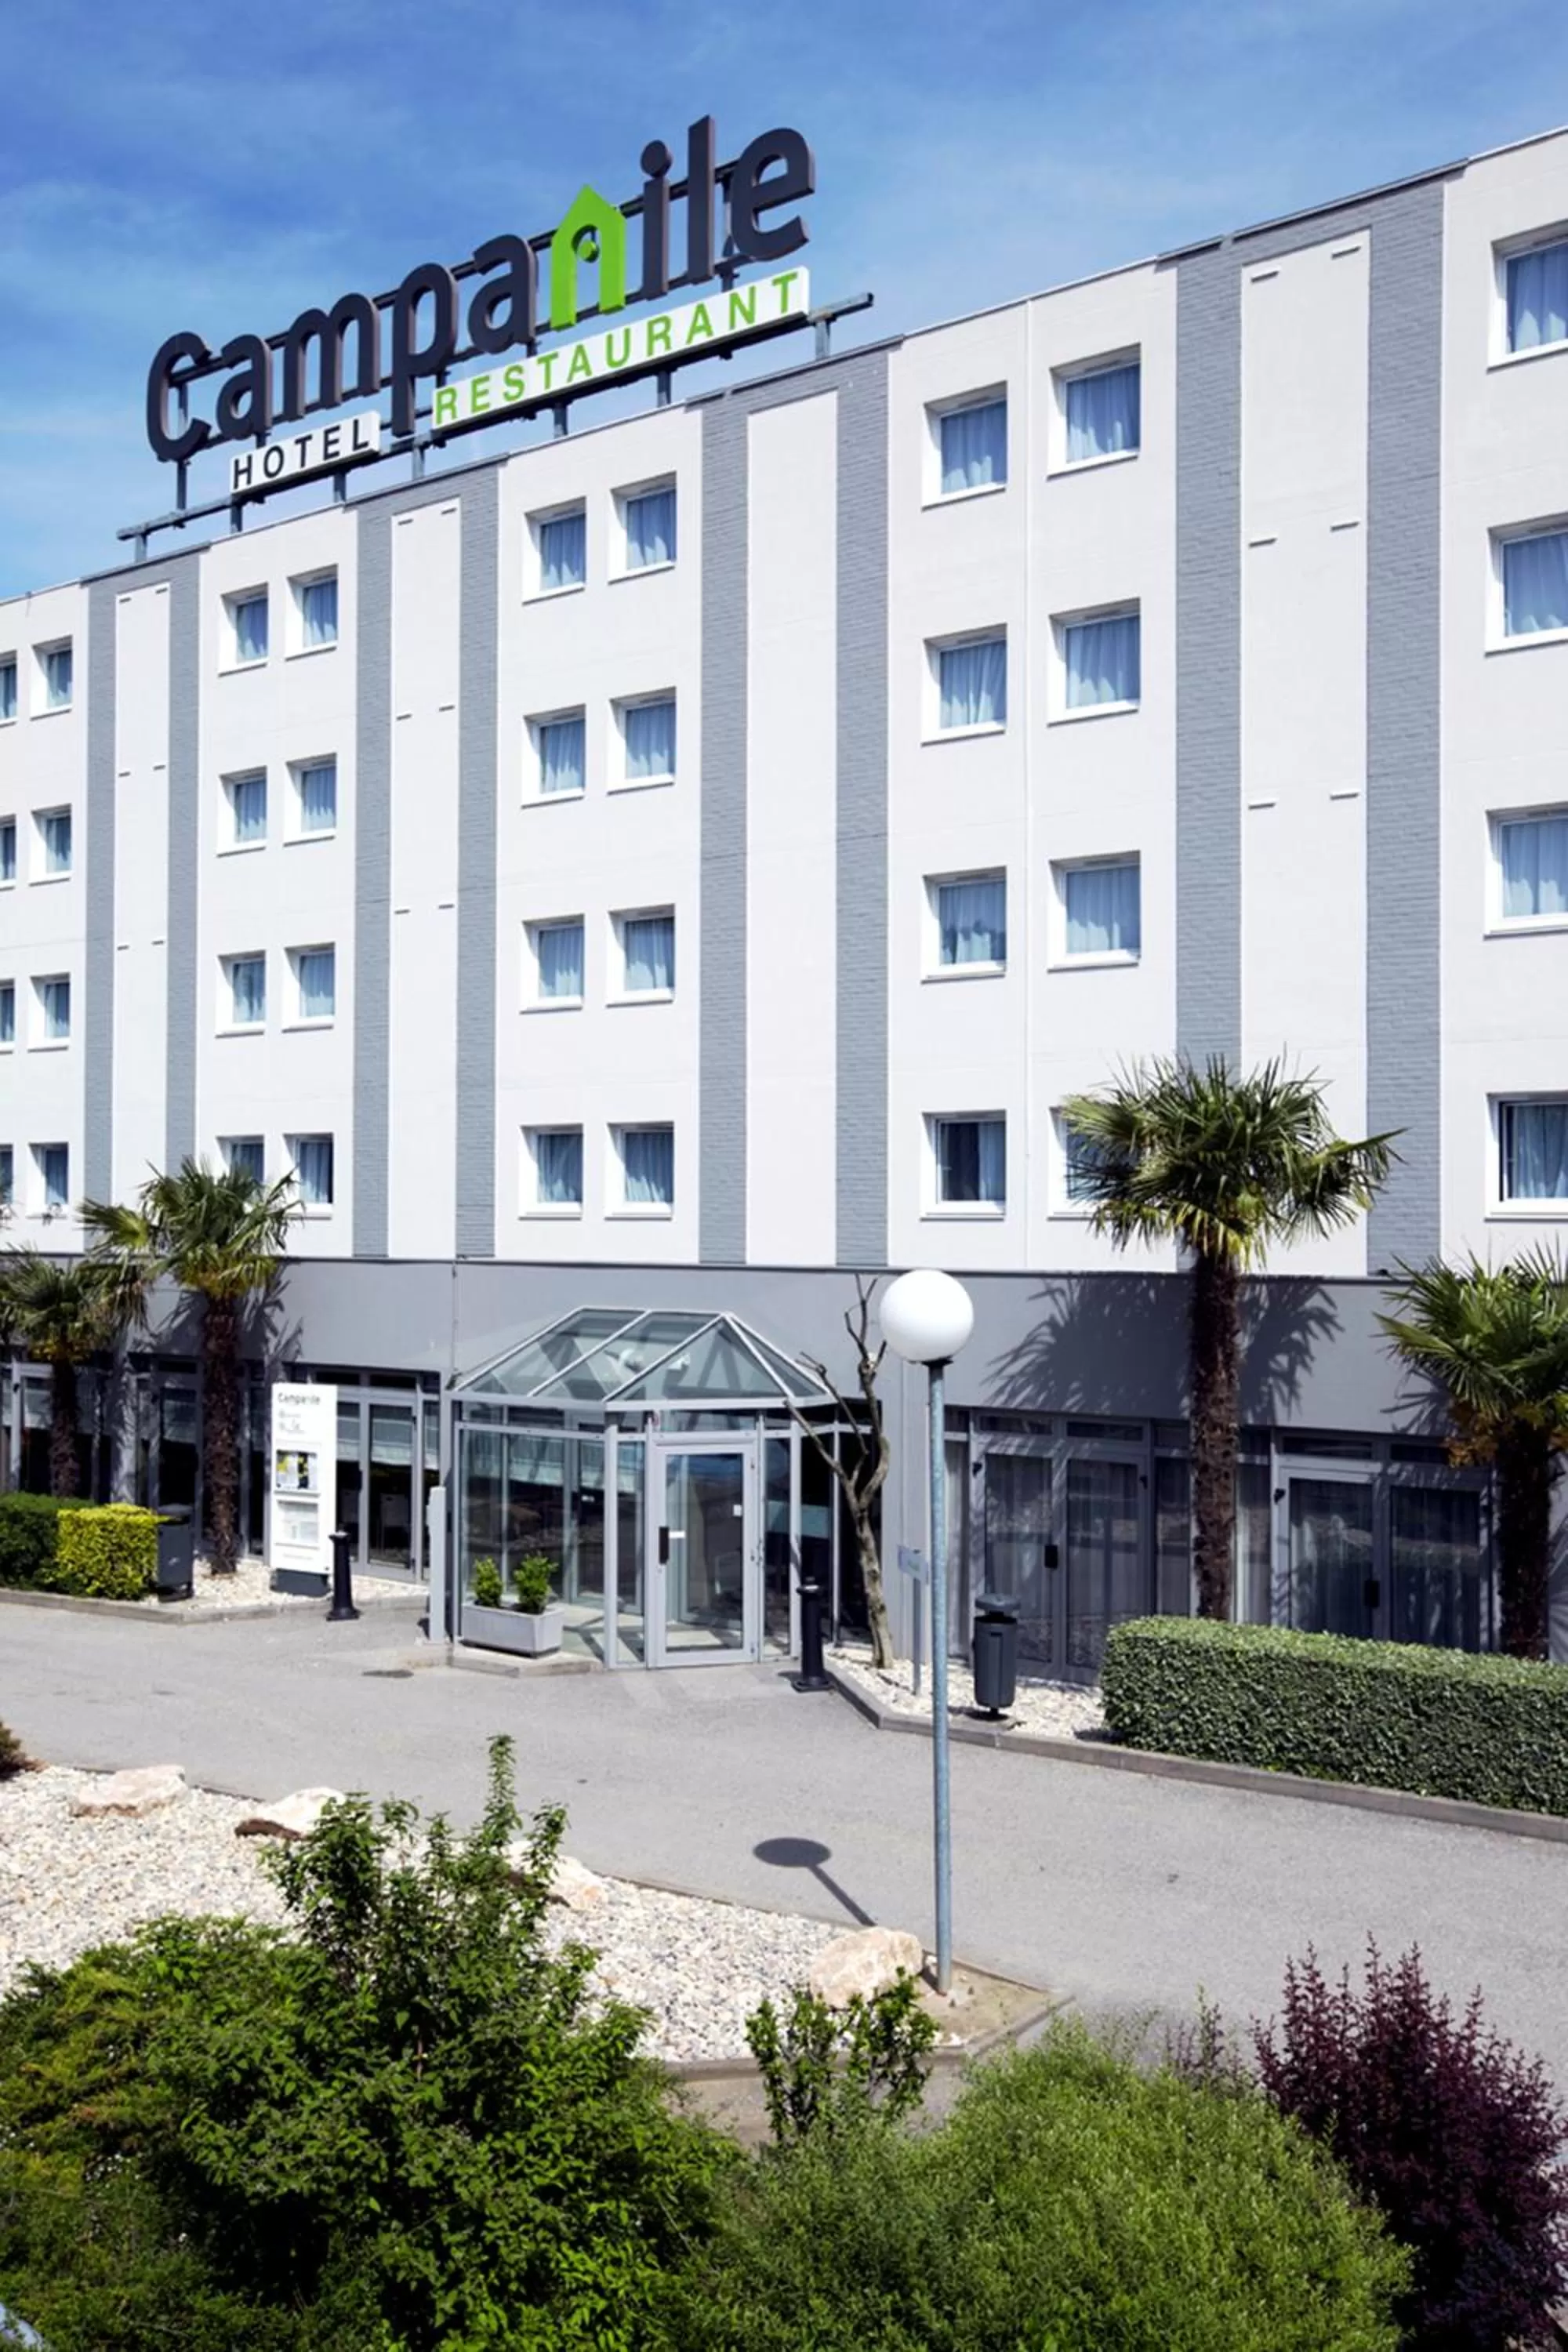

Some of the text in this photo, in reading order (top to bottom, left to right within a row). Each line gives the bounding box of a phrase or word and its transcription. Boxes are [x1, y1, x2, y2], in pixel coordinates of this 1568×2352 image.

[147, 114, 816, 463] Campanile
[232, 270, 800, 492] HOTEL RESTAURANT
